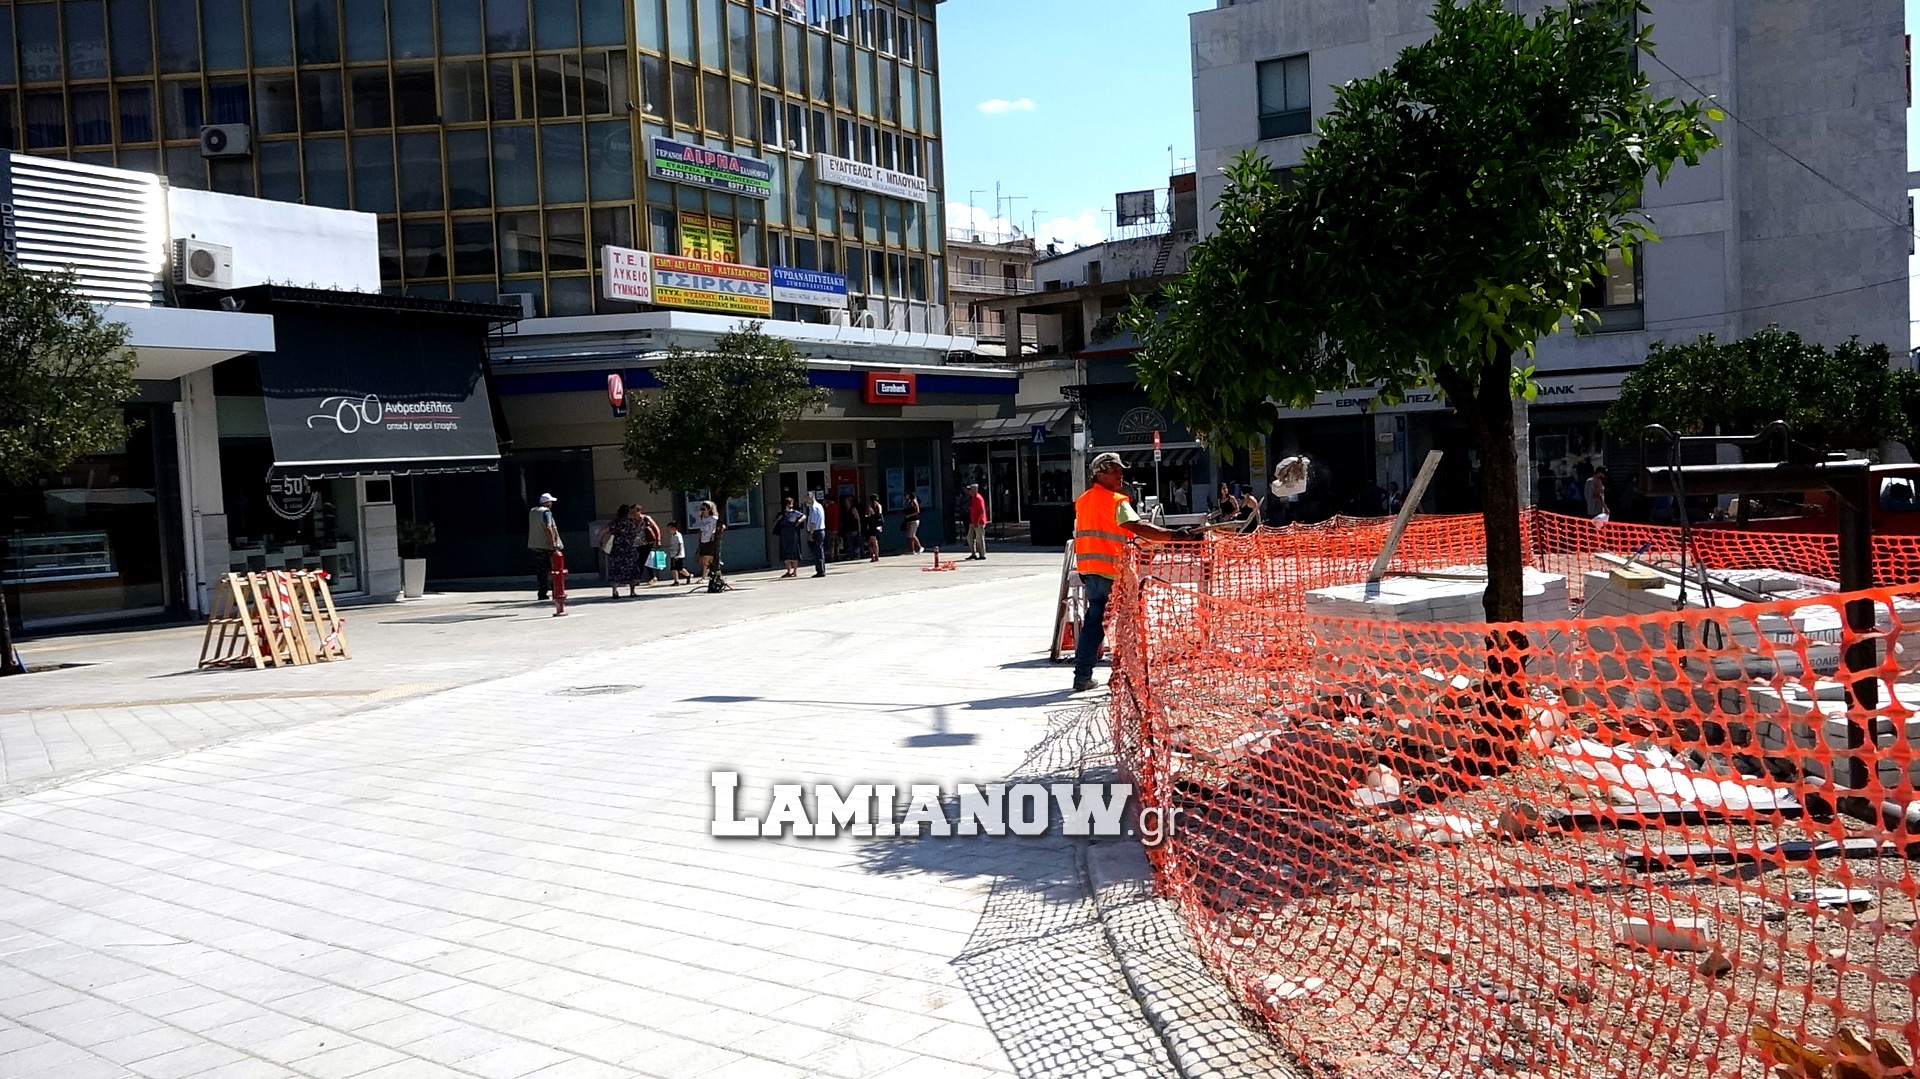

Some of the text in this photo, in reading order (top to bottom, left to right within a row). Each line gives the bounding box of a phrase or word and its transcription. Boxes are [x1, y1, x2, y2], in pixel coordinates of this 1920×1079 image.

[683, 147, 740, 172] ALPHA
[829, 159, 872, 179] ΕΥΑΓΓΕΛΟΣ
[613, 268, 648, 283] ΛΥΚΕΙΟ
[657, 271, 767, 296] ΤΣΙΡΚΑΣ
[613, 282, 649, 298] ΓΥΜΝΑΣΙΟ
[881, 383, 907, 393] Eurobank
